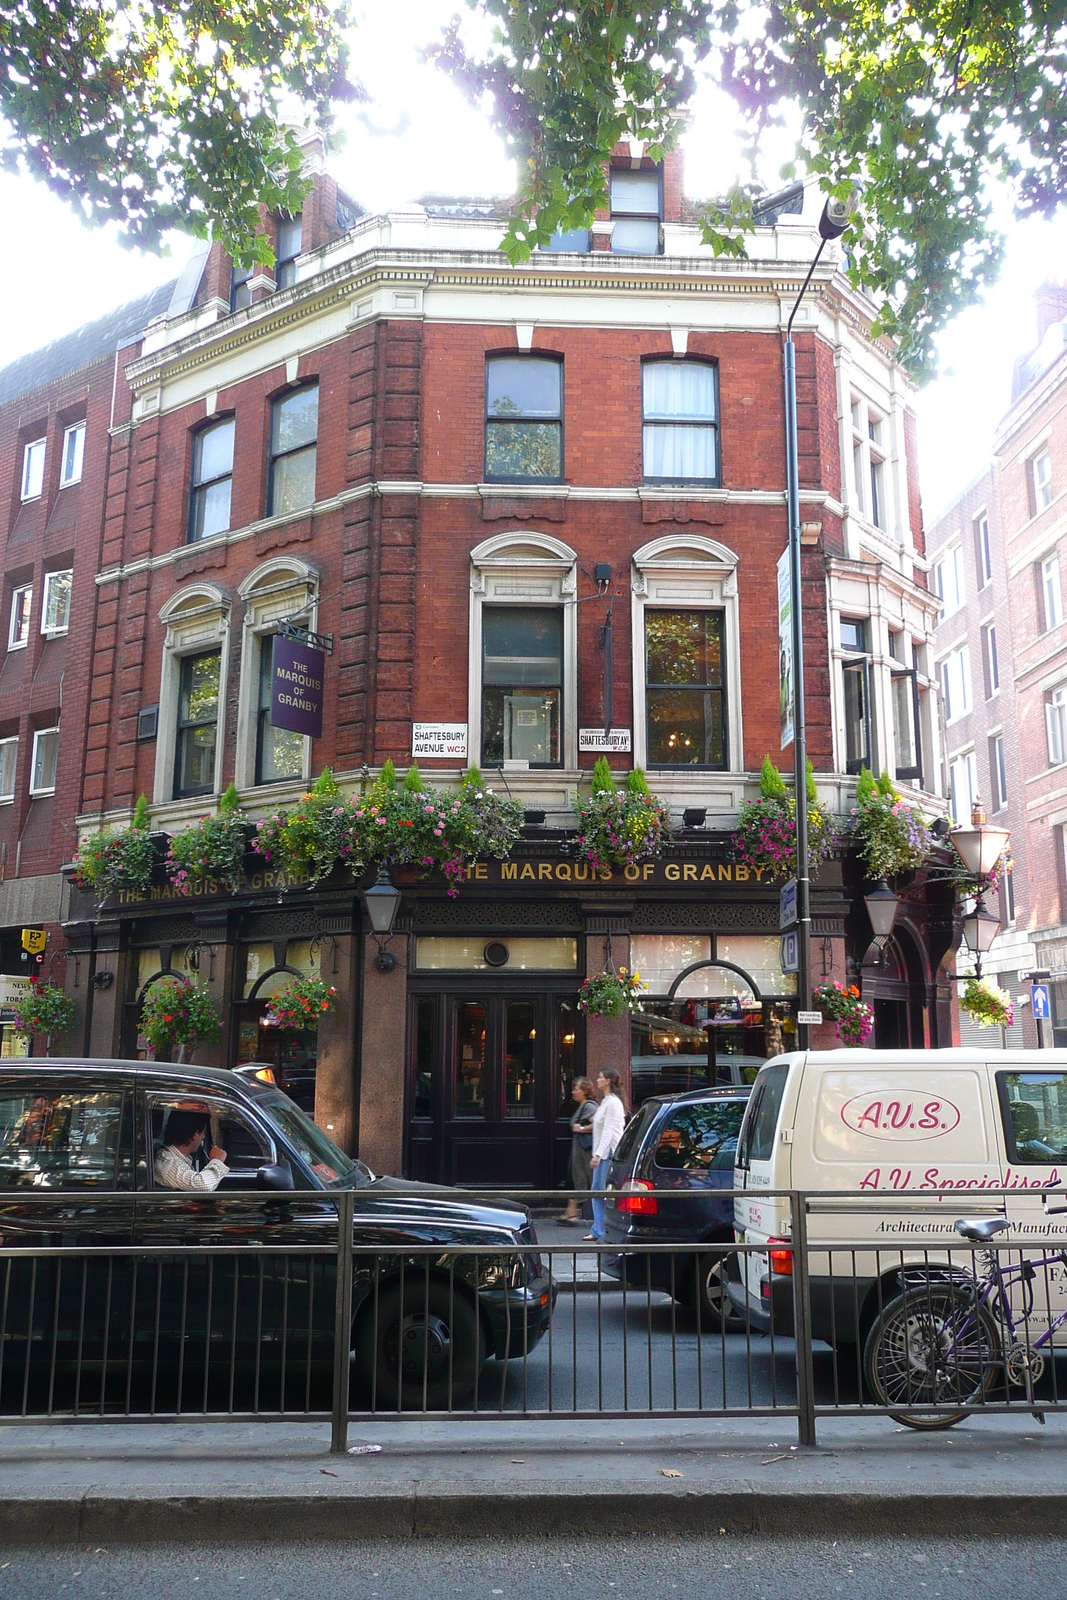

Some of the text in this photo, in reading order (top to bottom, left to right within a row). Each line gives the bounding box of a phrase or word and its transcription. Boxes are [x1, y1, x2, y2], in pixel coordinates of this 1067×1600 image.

[293, 661, 308, 673] THE
[277, 668, 321, 690] MARQUIS
[294, 687, 304, 696] OF
[279, 693, 317, 712] GRANBY
[414, 732, 465, 741] SHAFTESBURY
[580, 735, 621, 745] SHAFTESBURY
[415, 744, 444, 752] AVENUE
[501, 863, 613, 881] MARQUIS
[624, 864, 655, 881] OF
[664, 864, 766, 881] GRANBY
[118, 888, 147, 904] THE
[251, 871, 312, 890] GRANB
[875, 1221, 956, 1232] Architectural
